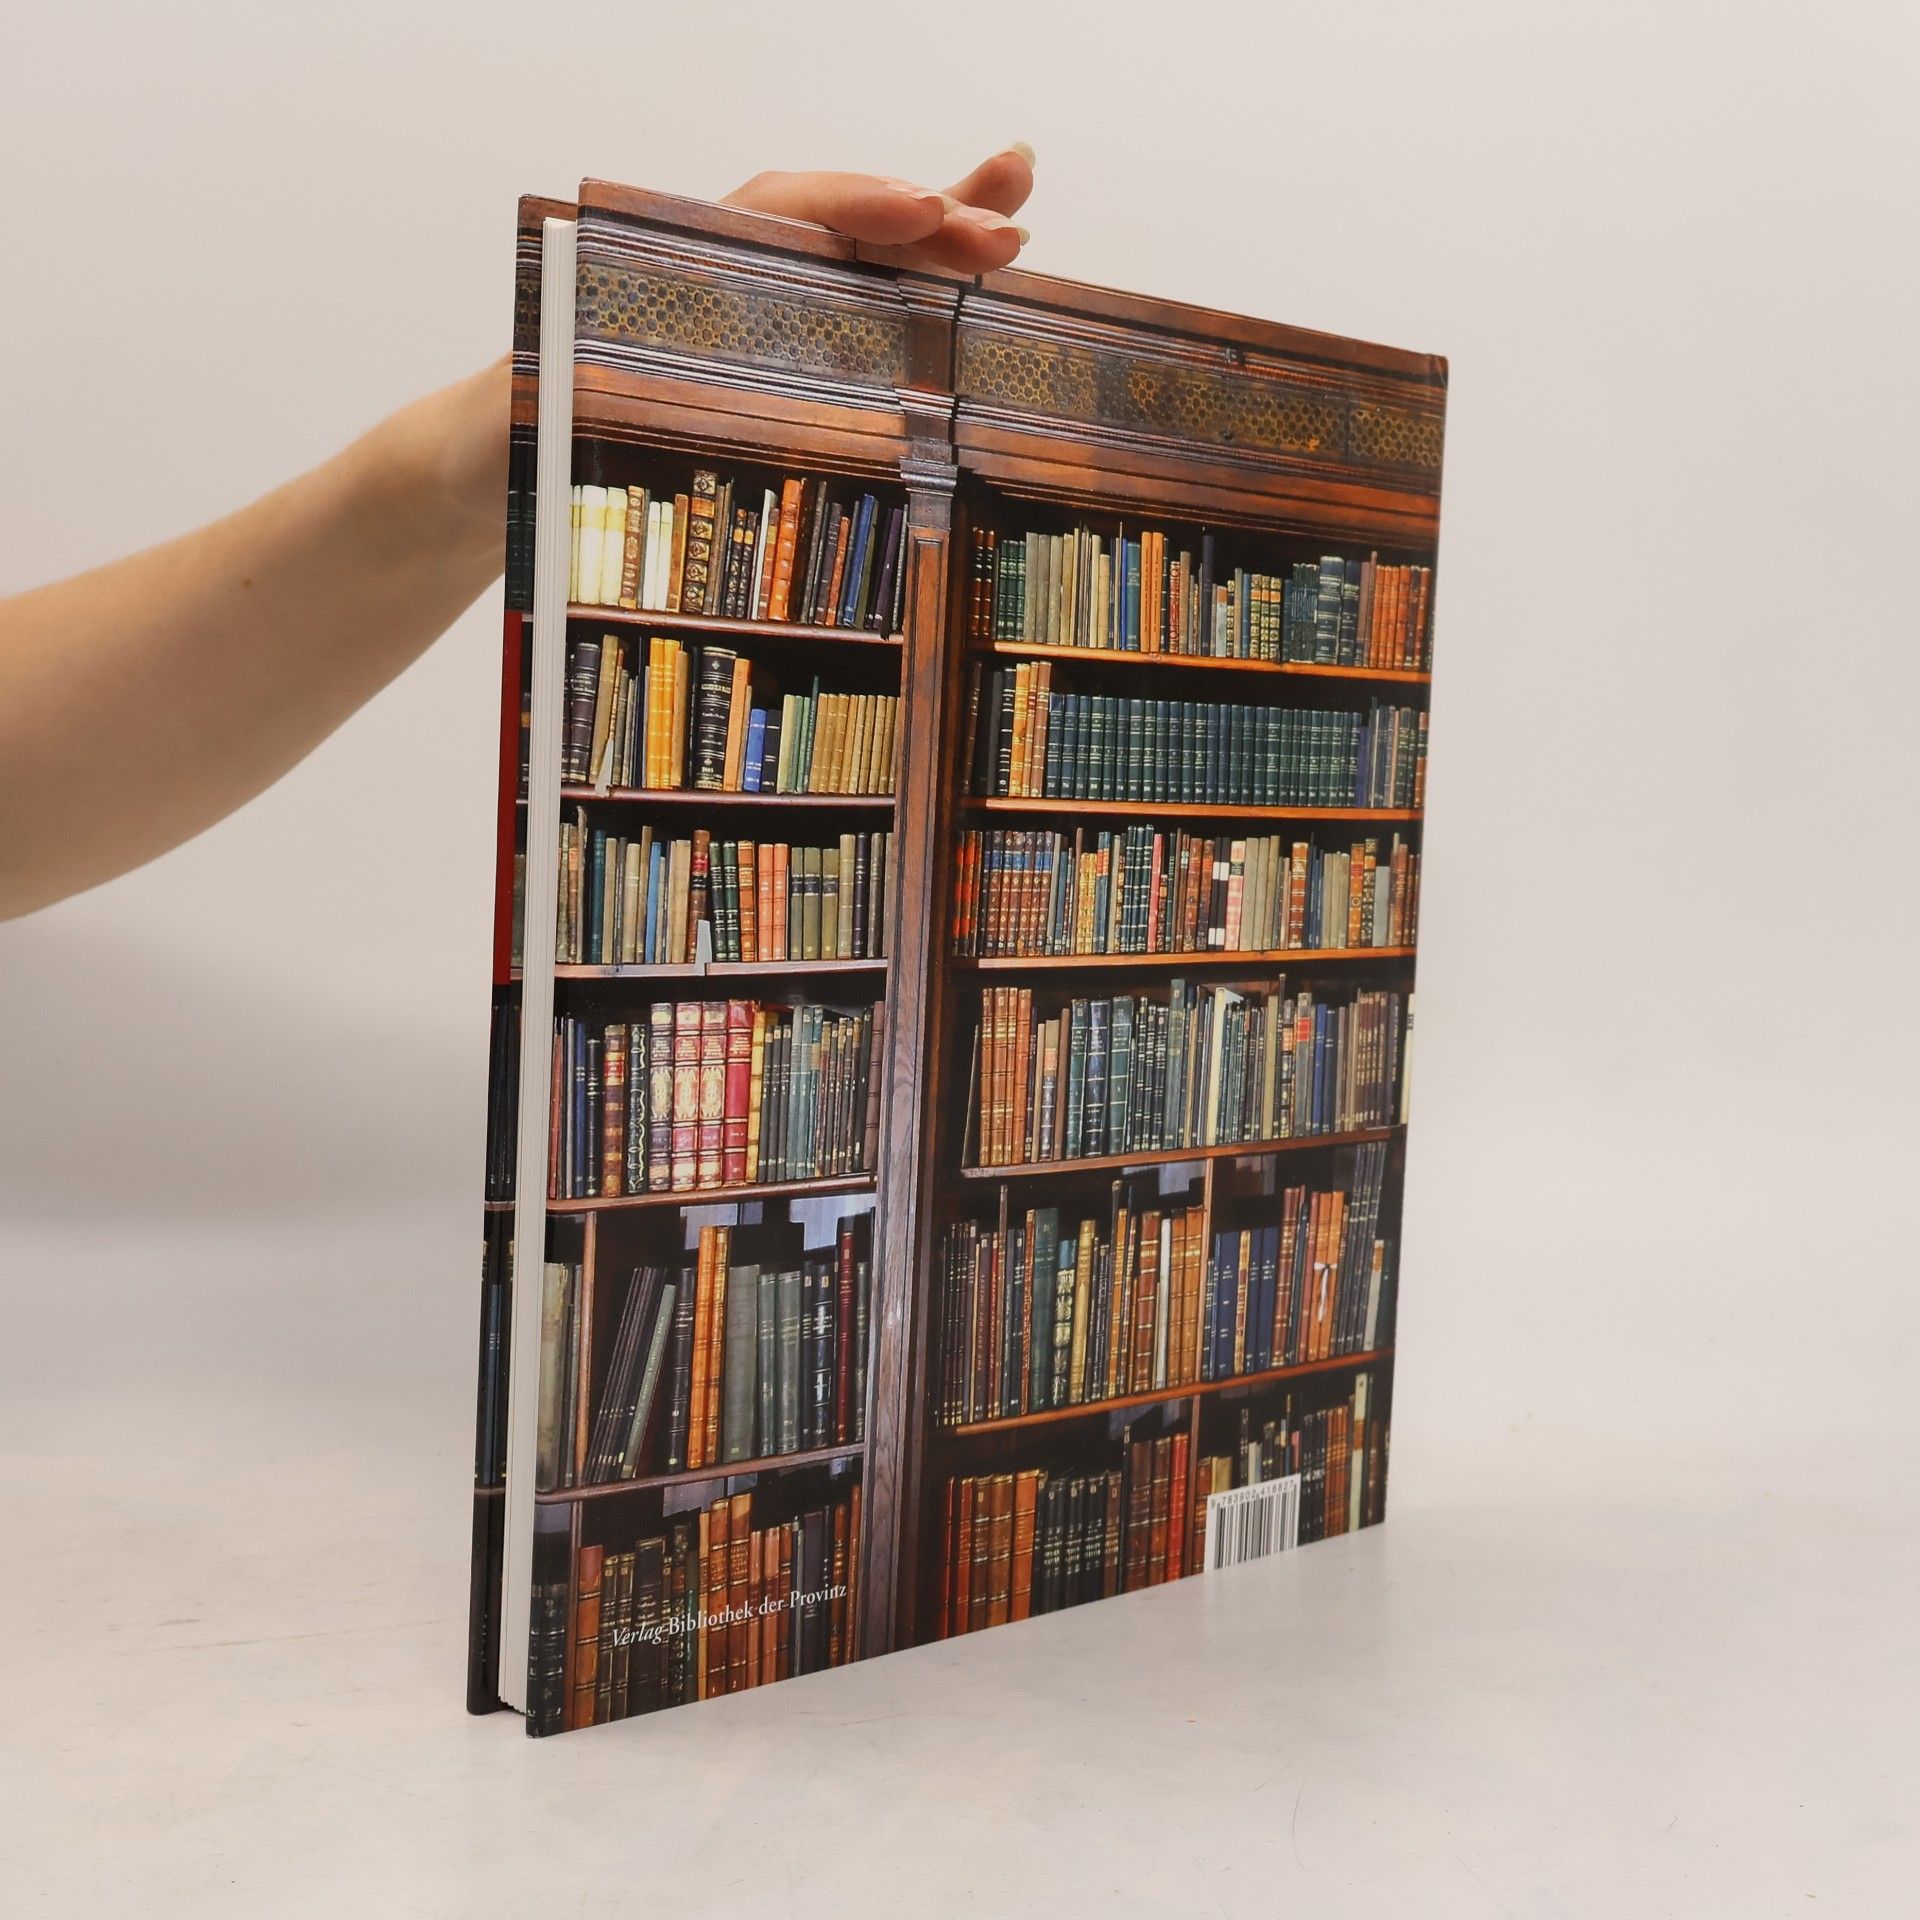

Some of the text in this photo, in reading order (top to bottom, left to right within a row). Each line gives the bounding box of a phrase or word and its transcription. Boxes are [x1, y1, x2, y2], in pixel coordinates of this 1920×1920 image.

[612, 1583, 848, 1647] Verlag Bibliothek der Provinz
